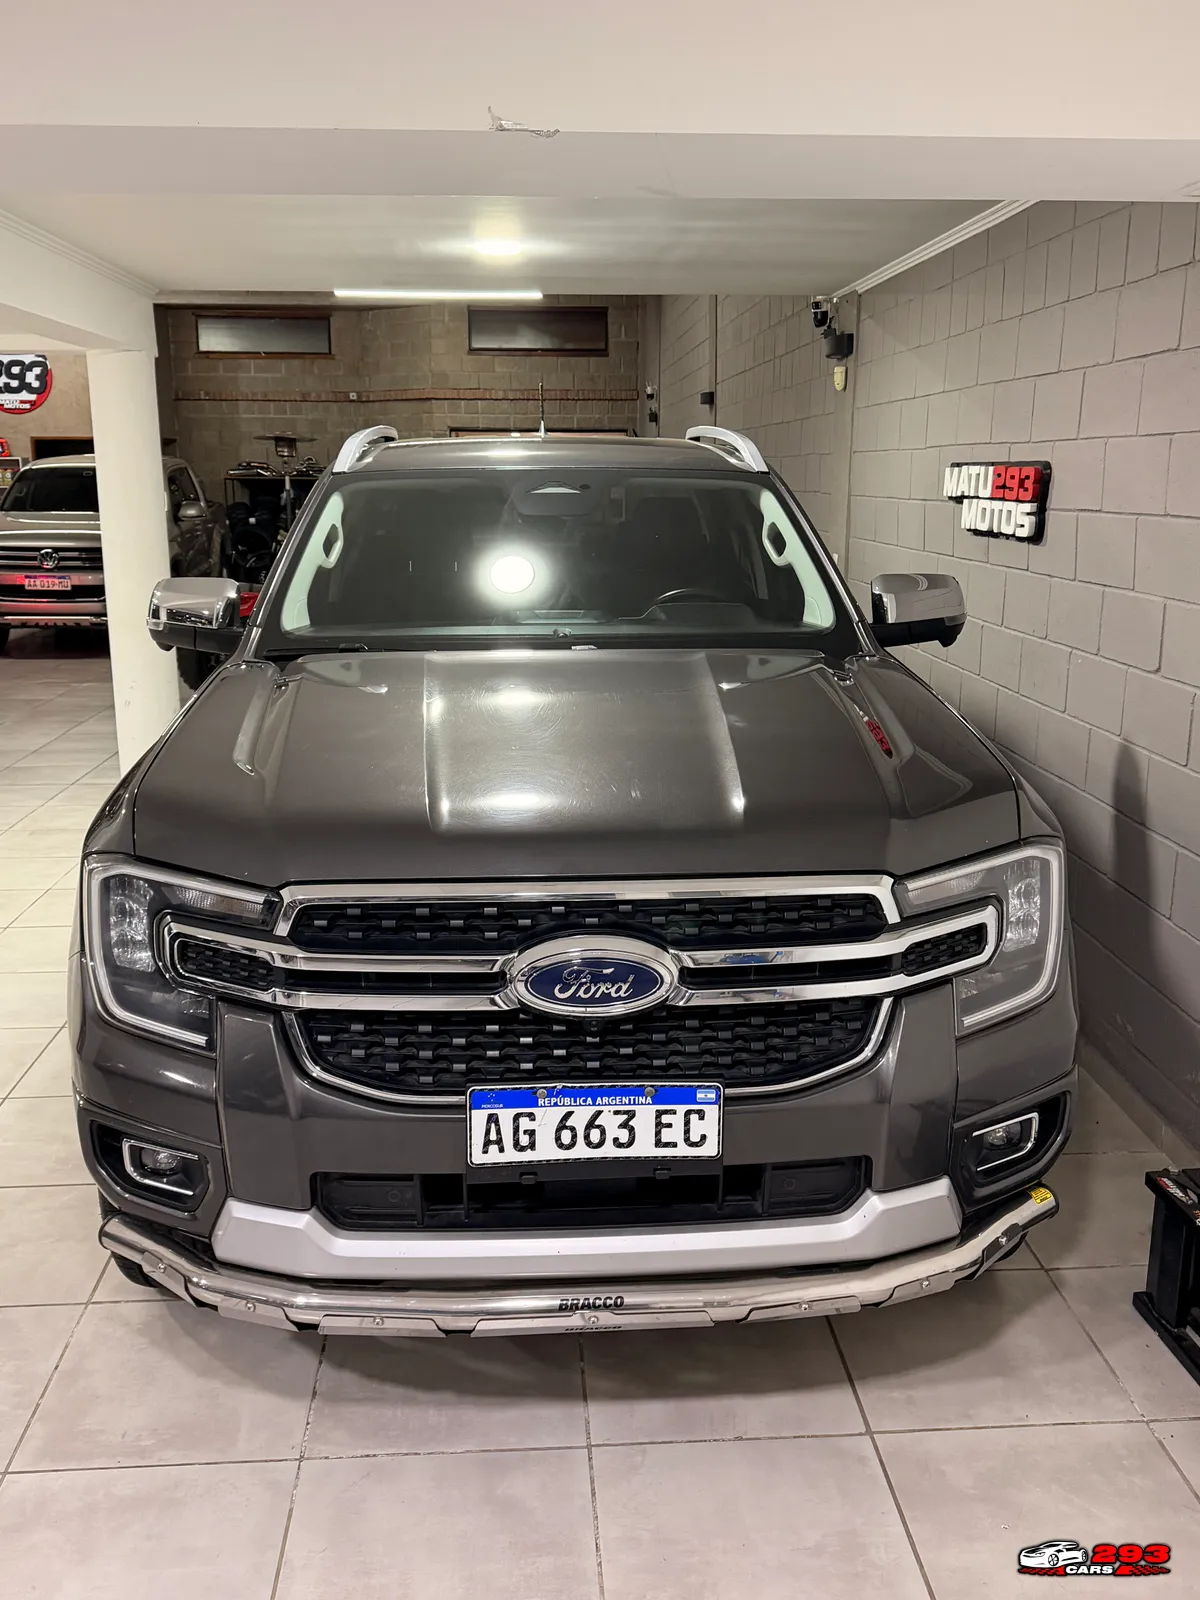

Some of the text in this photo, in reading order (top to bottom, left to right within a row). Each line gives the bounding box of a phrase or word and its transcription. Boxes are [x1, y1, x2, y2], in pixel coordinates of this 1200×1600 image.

[0, 359, 49, 395] 93
[961, 499, 1037, 538] MOTOS
[27, 580, 69, 589] AA 019 MU
[554, 966, 635, 999] Ford
[538, 1095, 653, 1107] REPÚBLICA ARGENTINA
[481, 1108, 707, 1154] AG 663 EC
[558, 1296, 625, 1311] BRACCO
